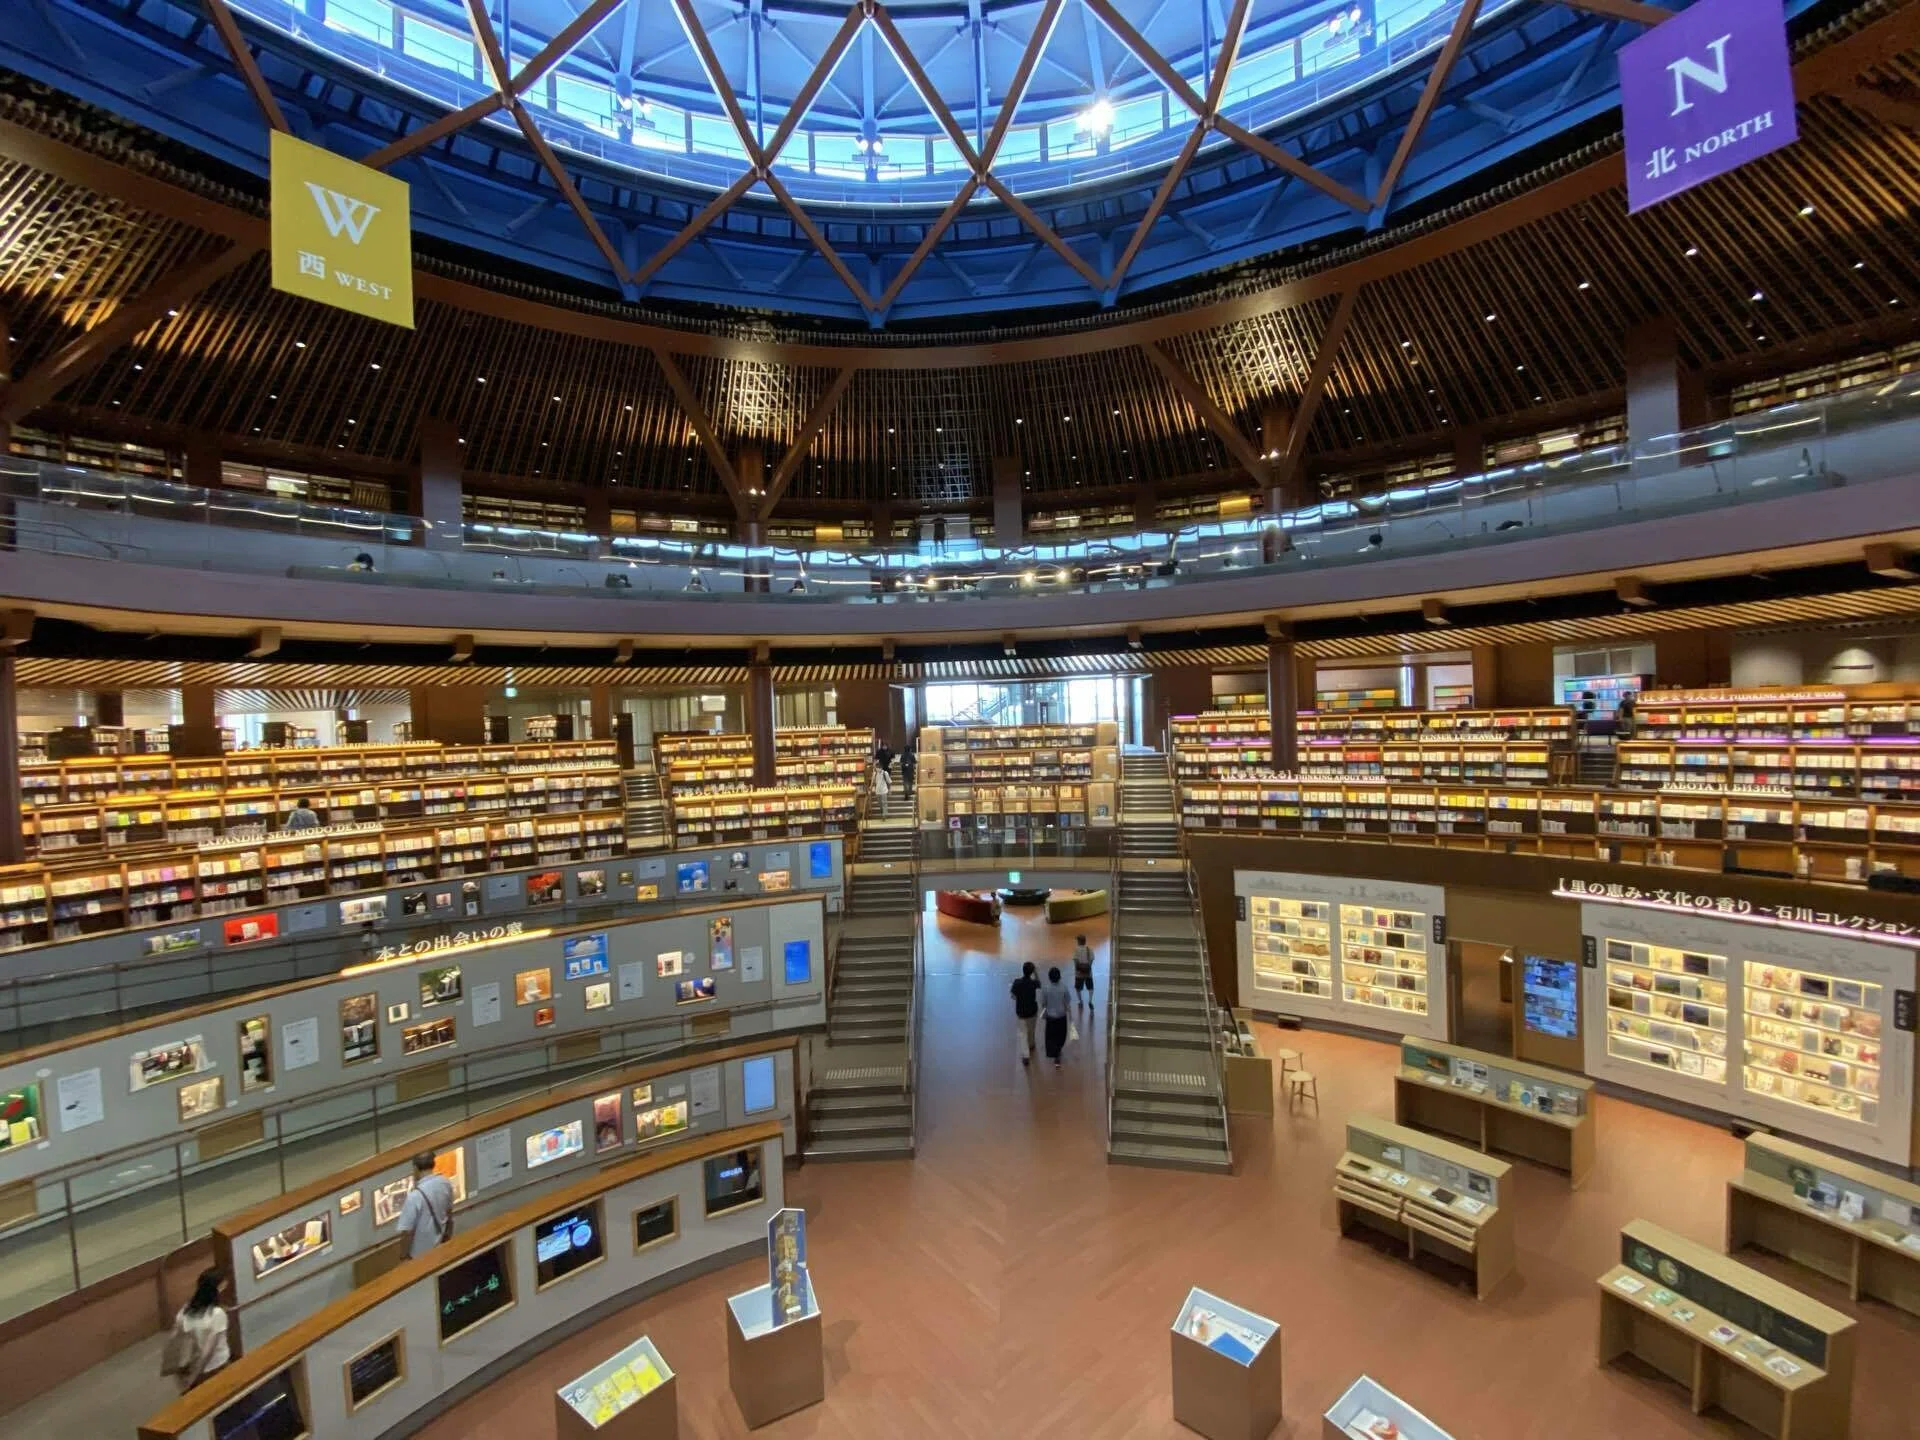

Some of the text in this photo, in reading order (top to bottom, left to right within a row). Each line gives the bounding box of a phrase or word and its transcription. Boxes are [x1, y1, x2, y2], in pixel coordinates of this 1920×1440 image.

[1665, 33, 1732, 117] N
[1646, 111, 1774, 180] 北 NORTH
[303, 180, 381, 245] W
[297, 250, 392, 300] 西 WEST
[1295, 774, 1332, 782] THINKING
[1334, 774, 1360, 782] ABOUT
[1363, 774, 1386, 782] WORK
[1733, 783, 1792, 794] БИЗНЕС
[267, 830, 292, 841] SEU
[295, 826, 333, 838] MODO
[336, 824, 352, 834] DE
[355, 821, 384, 832] VIDA
[376, 921, 524, 962] 本との出会いの窓
